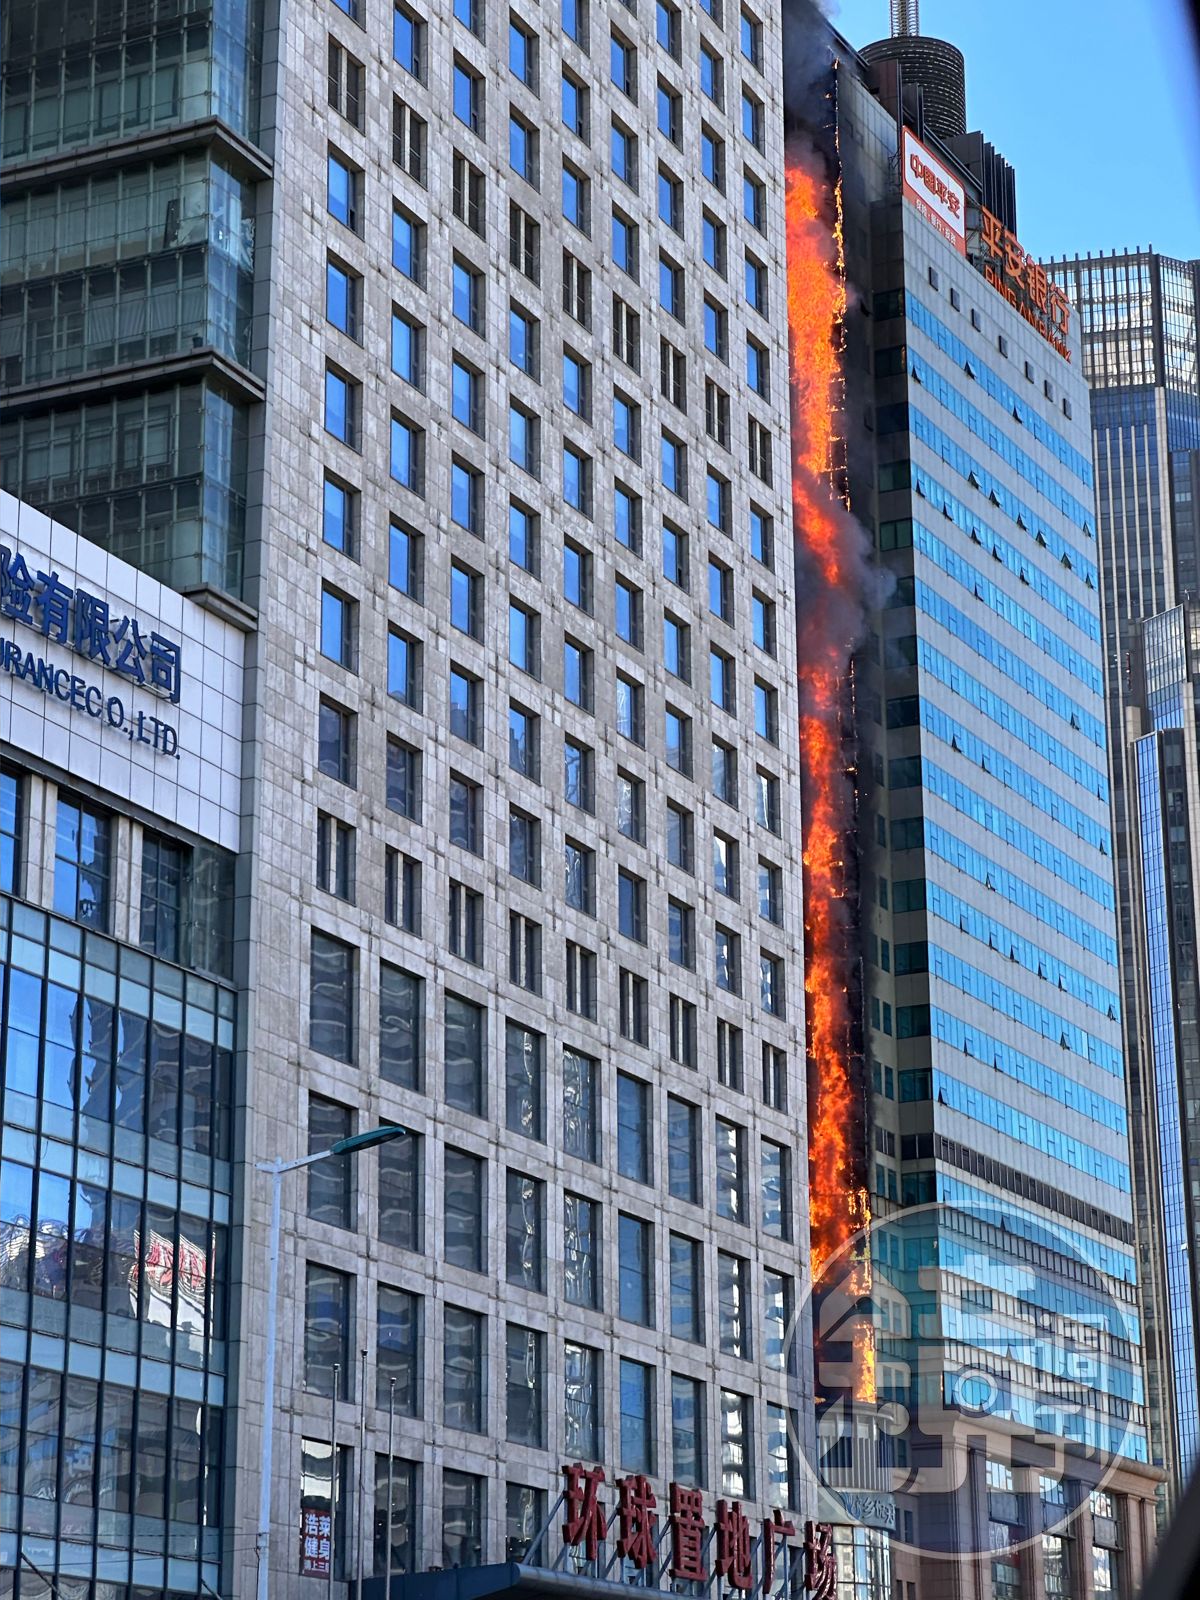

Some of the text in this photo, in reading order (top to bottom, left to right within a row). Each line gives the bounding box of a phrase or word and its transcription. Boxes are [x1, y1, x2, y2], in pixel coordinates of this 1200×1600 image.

[910, 153, 960, 219] 中国平安
[981, 205, 1070, 335] 平安银行
[985, 265, 1017, 309] PING
[562, 1462, 837, 1600] 环球置地广场
